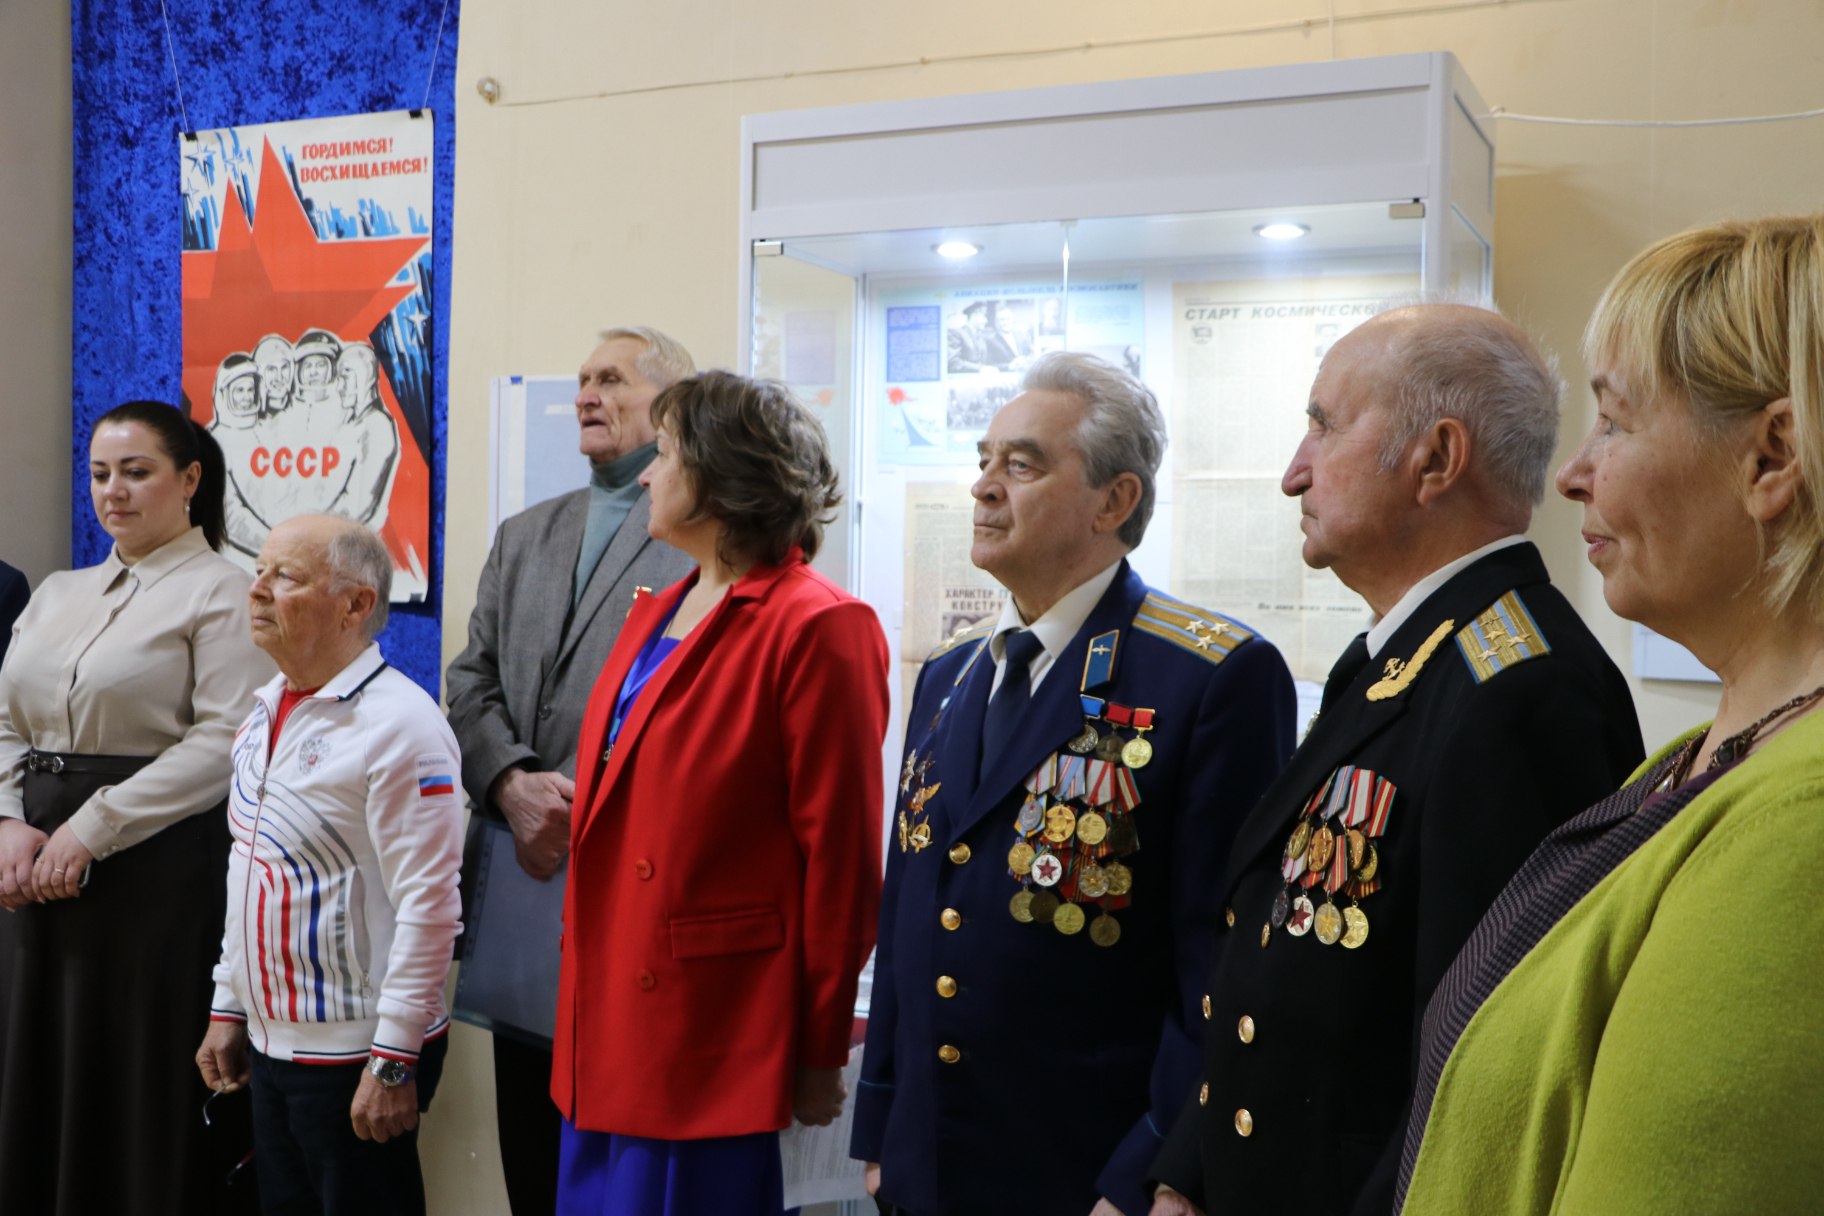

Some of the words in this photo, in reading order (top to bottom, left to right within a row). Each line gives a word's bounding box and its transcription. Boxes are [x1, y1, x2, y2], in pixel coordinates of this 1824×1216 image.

[302, 137, 393, 160] ГОРДИМСЯ!
[300, 156, 428, 183] ВОСХИЩАЕМСЯ!
[1185, 307, 1242, 320] СТАРТ
[250, 446, 340, 478] СССР
[946, 588, 994, 599] ХАРАКТЕР
